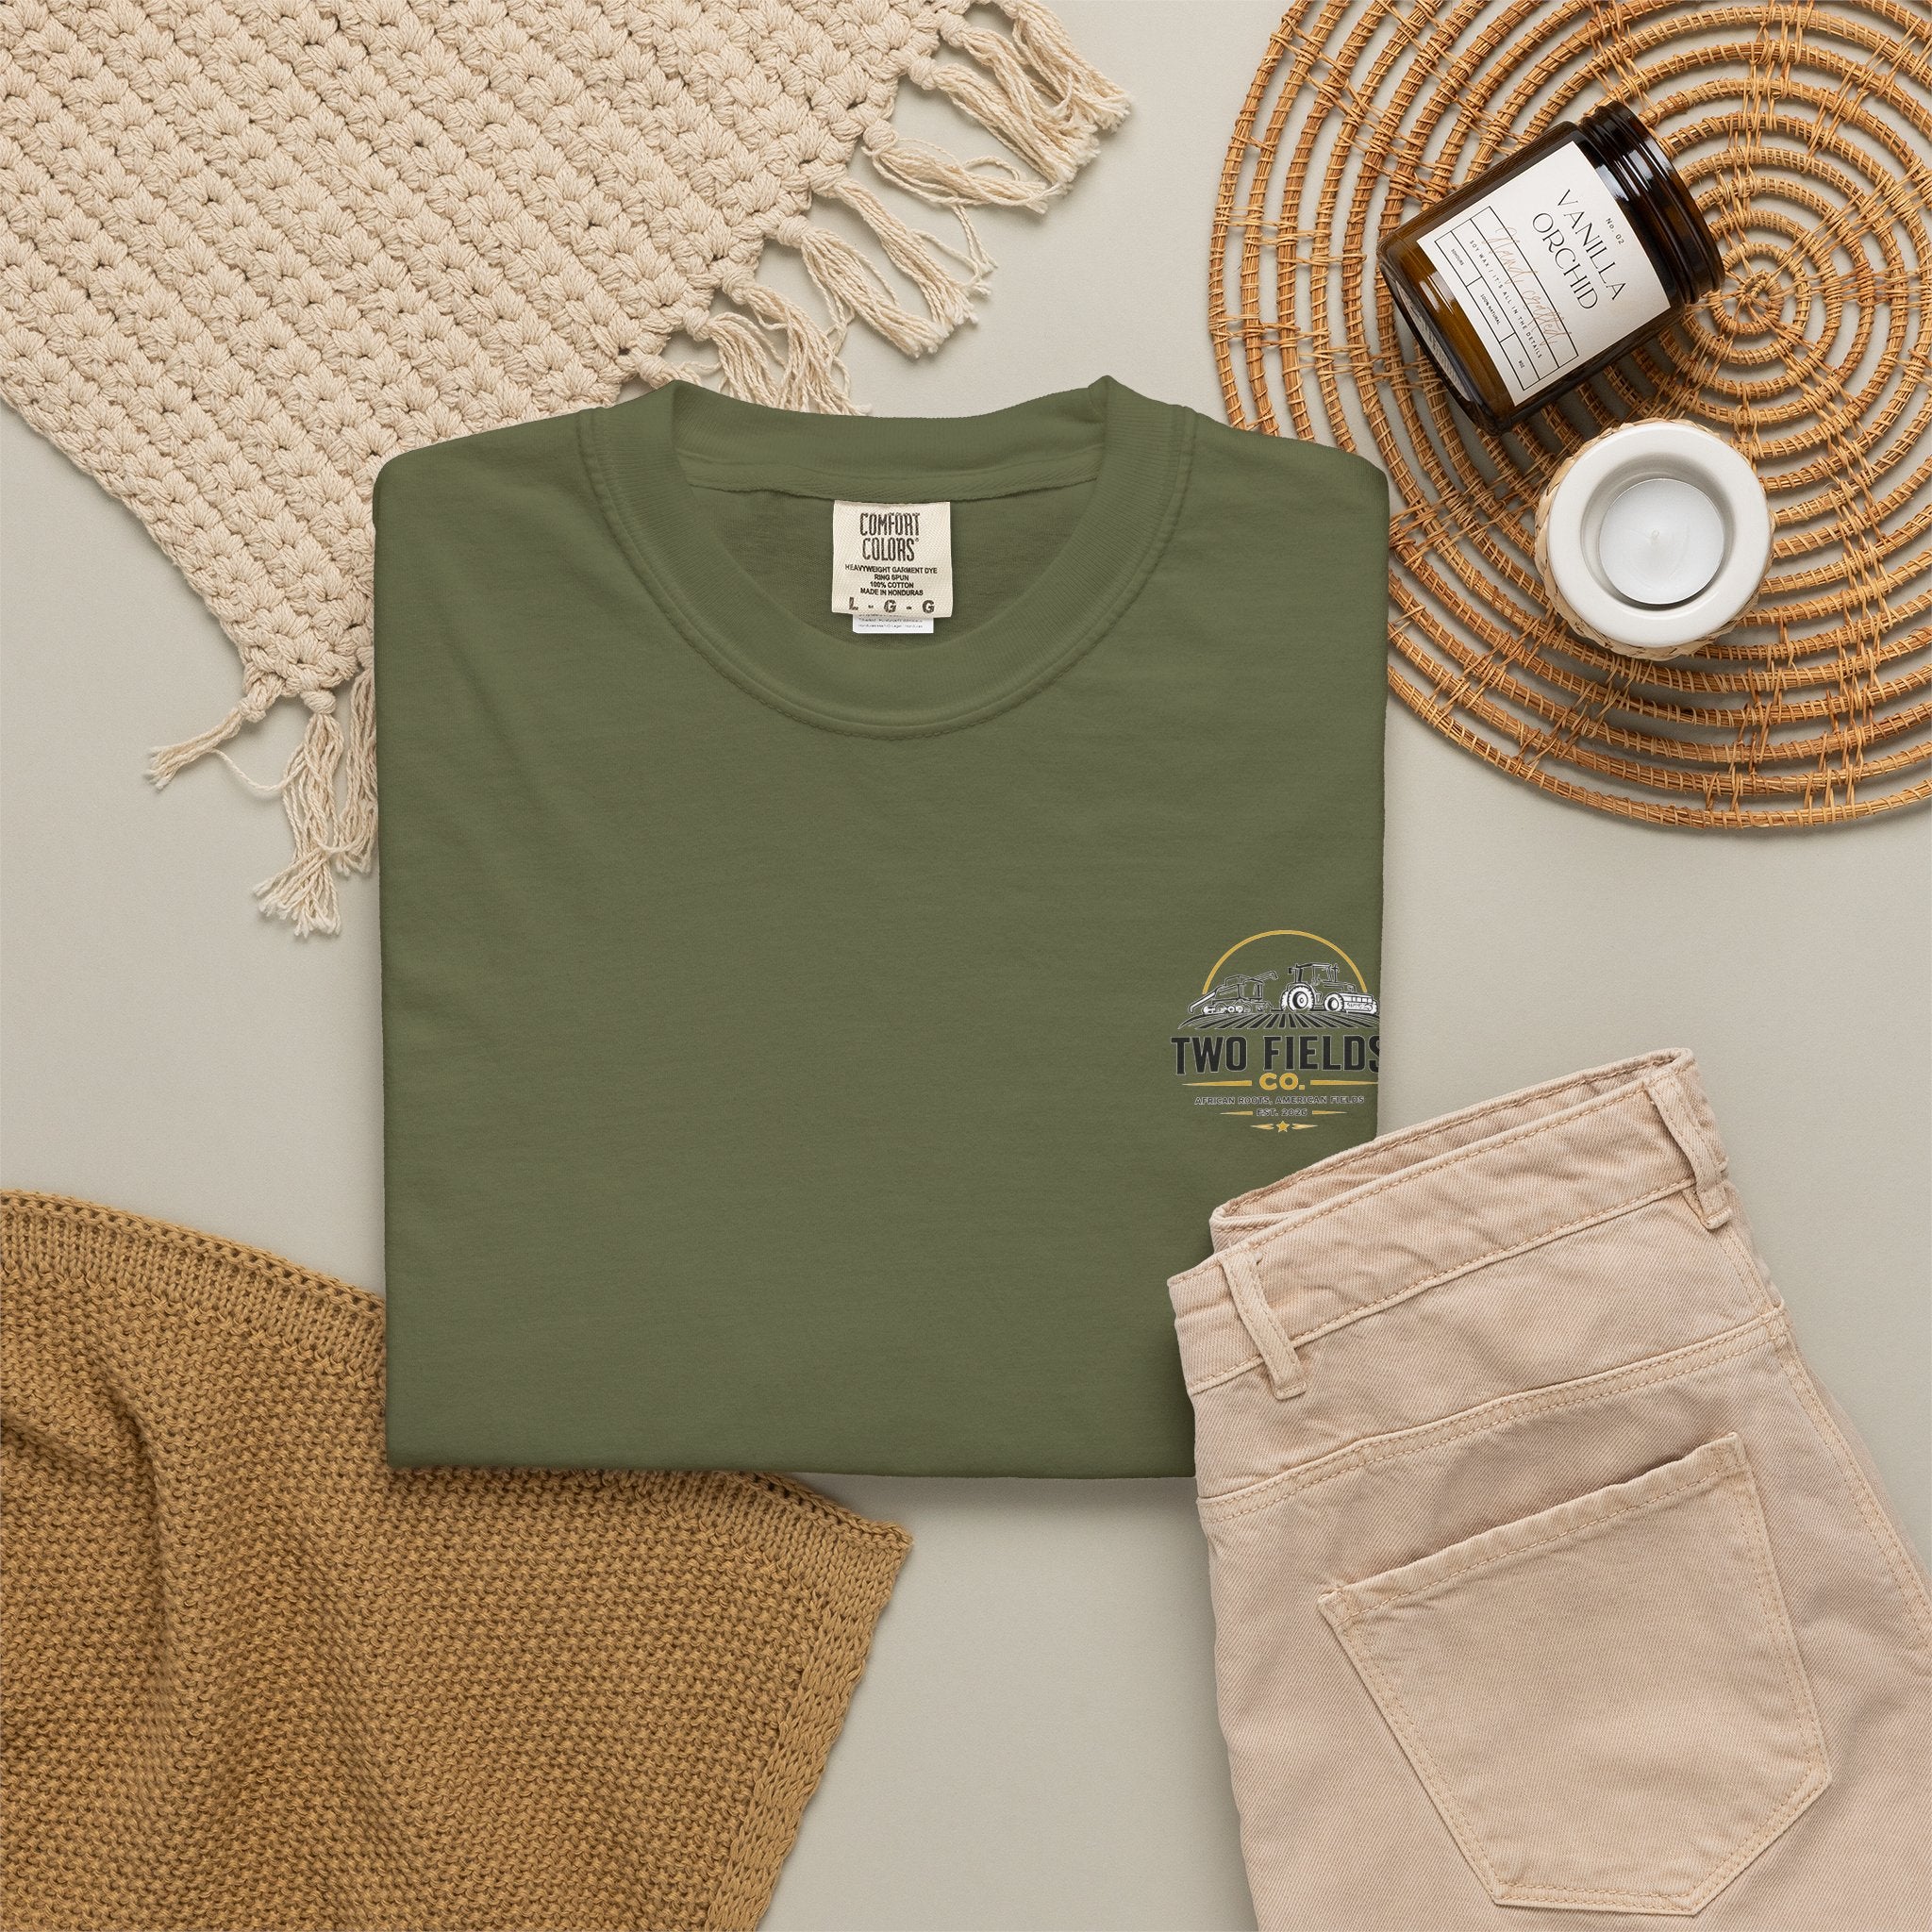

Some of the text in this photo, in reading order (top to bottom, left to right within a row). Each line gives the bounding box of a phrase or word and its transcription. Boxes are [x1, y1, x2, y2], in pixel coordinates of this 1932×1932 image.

[1606, 218, 1624, 245] No. 02
[1481, 226, 1538, 285] Hand
[1557, 189, 1626, 300] VANILLA
[1532, 212, 1599, 310] ORCHID
[1470, 240, 1479, 252] SOY
[1479, 254, 1489, 267] WAX
[1503, 291, 1512, 305] ALL
[1511, 307, 1518, 315] IN
[1518, 316, 1528, 330] THE
[1526, 331, 1542, 358] DETAILS
[1488, 305, 1501, 325] NATURAL
[859, 512, 921, 536] COMFORT
[844, 563, 891, 574] HEAVYWEIGHT
[849, 596, 858, 610] L
[883, 599, 897, 613] G
[922, 599, 935, 613] G
[1171, 1035, 1247, 1075] TWO
[1258, 1073, 1306, 1091] CO.
[1194, 1095, 1365, 1106] AFRICAN ROOTS, AMERICAN FIELDS
[1256, 1108, 1308, 1117] EST. 2026
